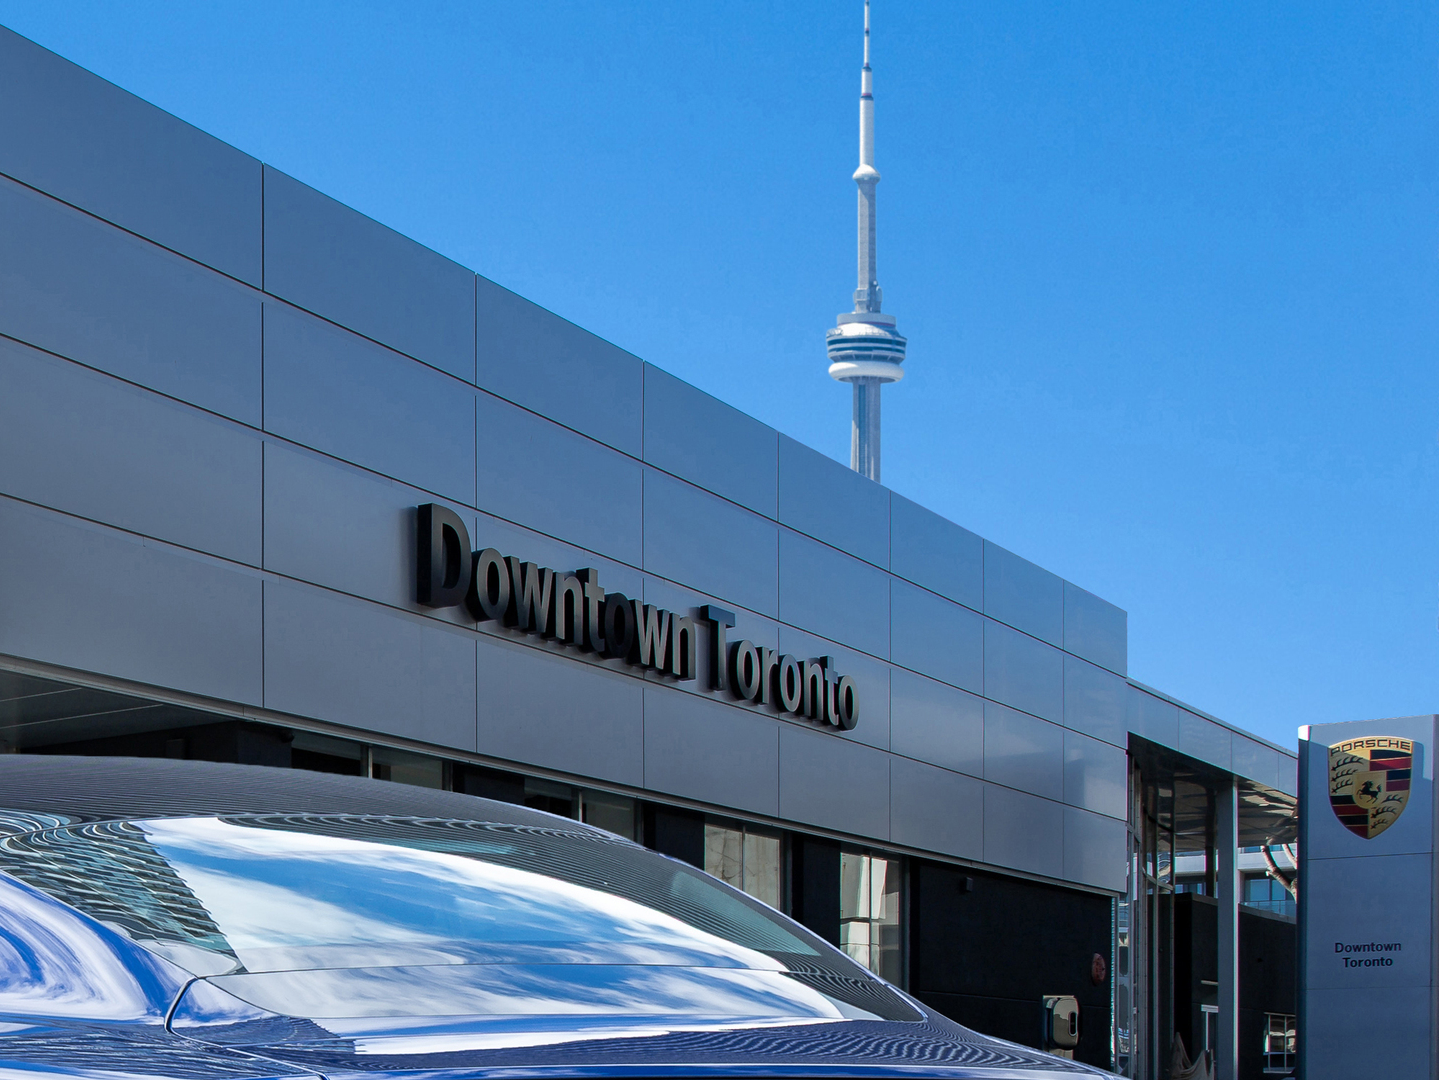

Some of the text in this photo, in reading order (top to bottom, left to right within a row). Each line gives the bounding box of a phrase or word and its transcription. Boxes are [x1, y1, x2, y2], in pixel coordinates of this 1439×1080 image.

[417, 503, 860, 732] Downtown Toronto
[1330, 738, 1411, 757] PORSCHE
[1334, 941, 1402, 953] Downtown
[1342, 956, 1394, 968] Toronto
